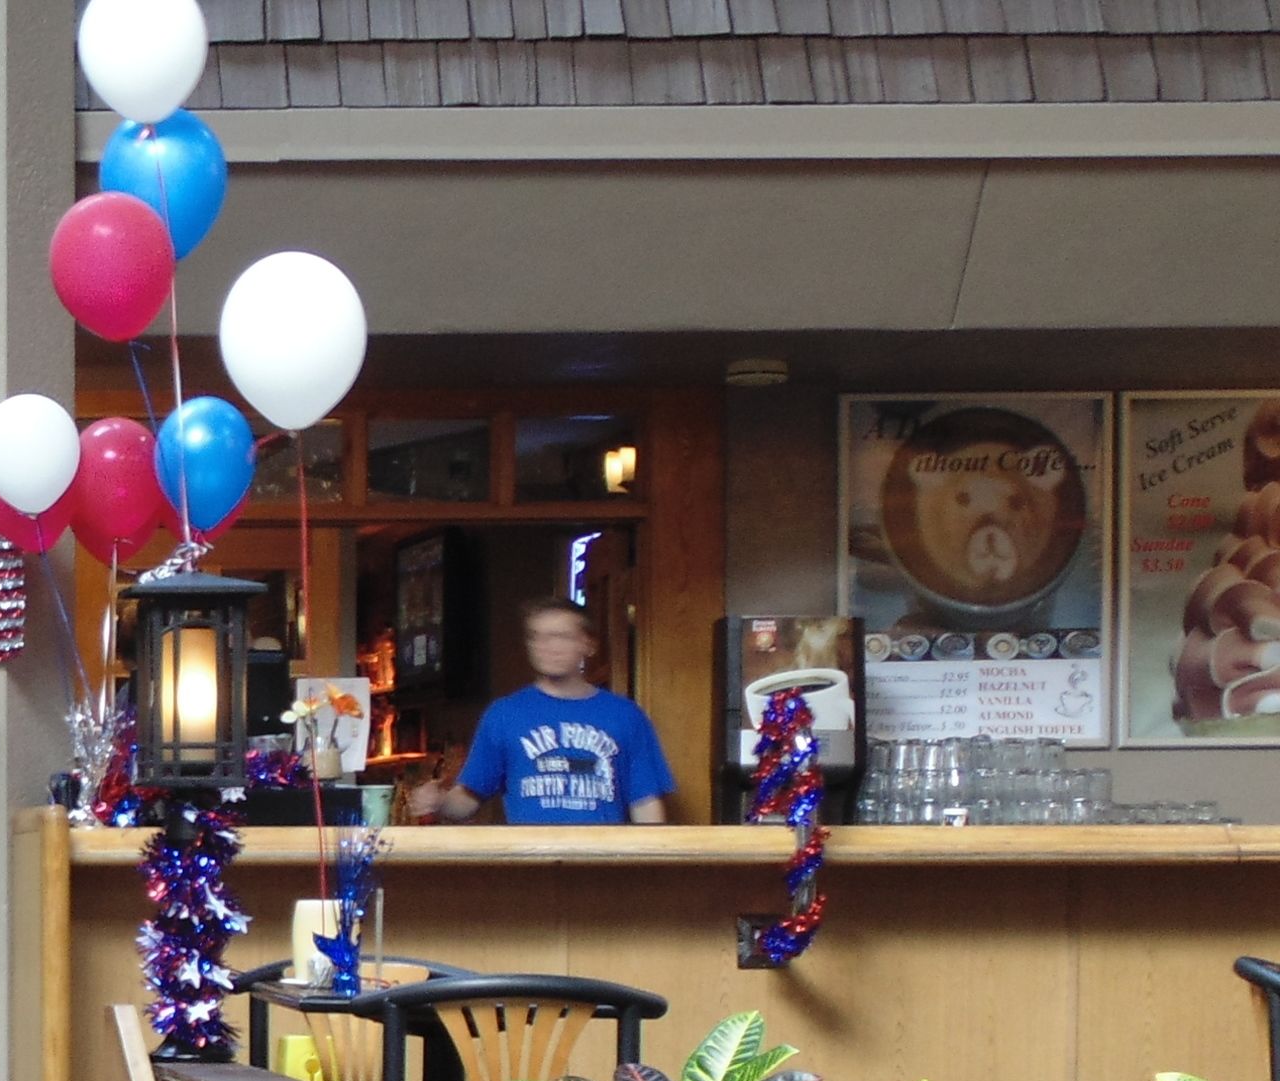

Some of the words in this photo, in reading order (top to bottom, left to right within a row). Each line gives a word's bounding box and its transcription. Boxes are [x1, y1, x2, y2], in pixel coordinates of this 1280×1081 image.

[1146, 428, 1183, 459] Soft
[1187, 407, 1237, 440] Serve
[1139, 469, 1168, 491] Ice
[1172, 438, 1234, 474] Cream
[979, 667, 1027, 677] MOCHA
[978, 681, 1047, 692] HAZELNUT
[978, 695, 1033, 705] VANILLA
[979, 711, 1034, 720] ALMOND
[978, 725, 1034, 735] ENGLISH
[1038, 724, 1085, 735] TOFFEE
[520, 724, 559, 760] AIR
